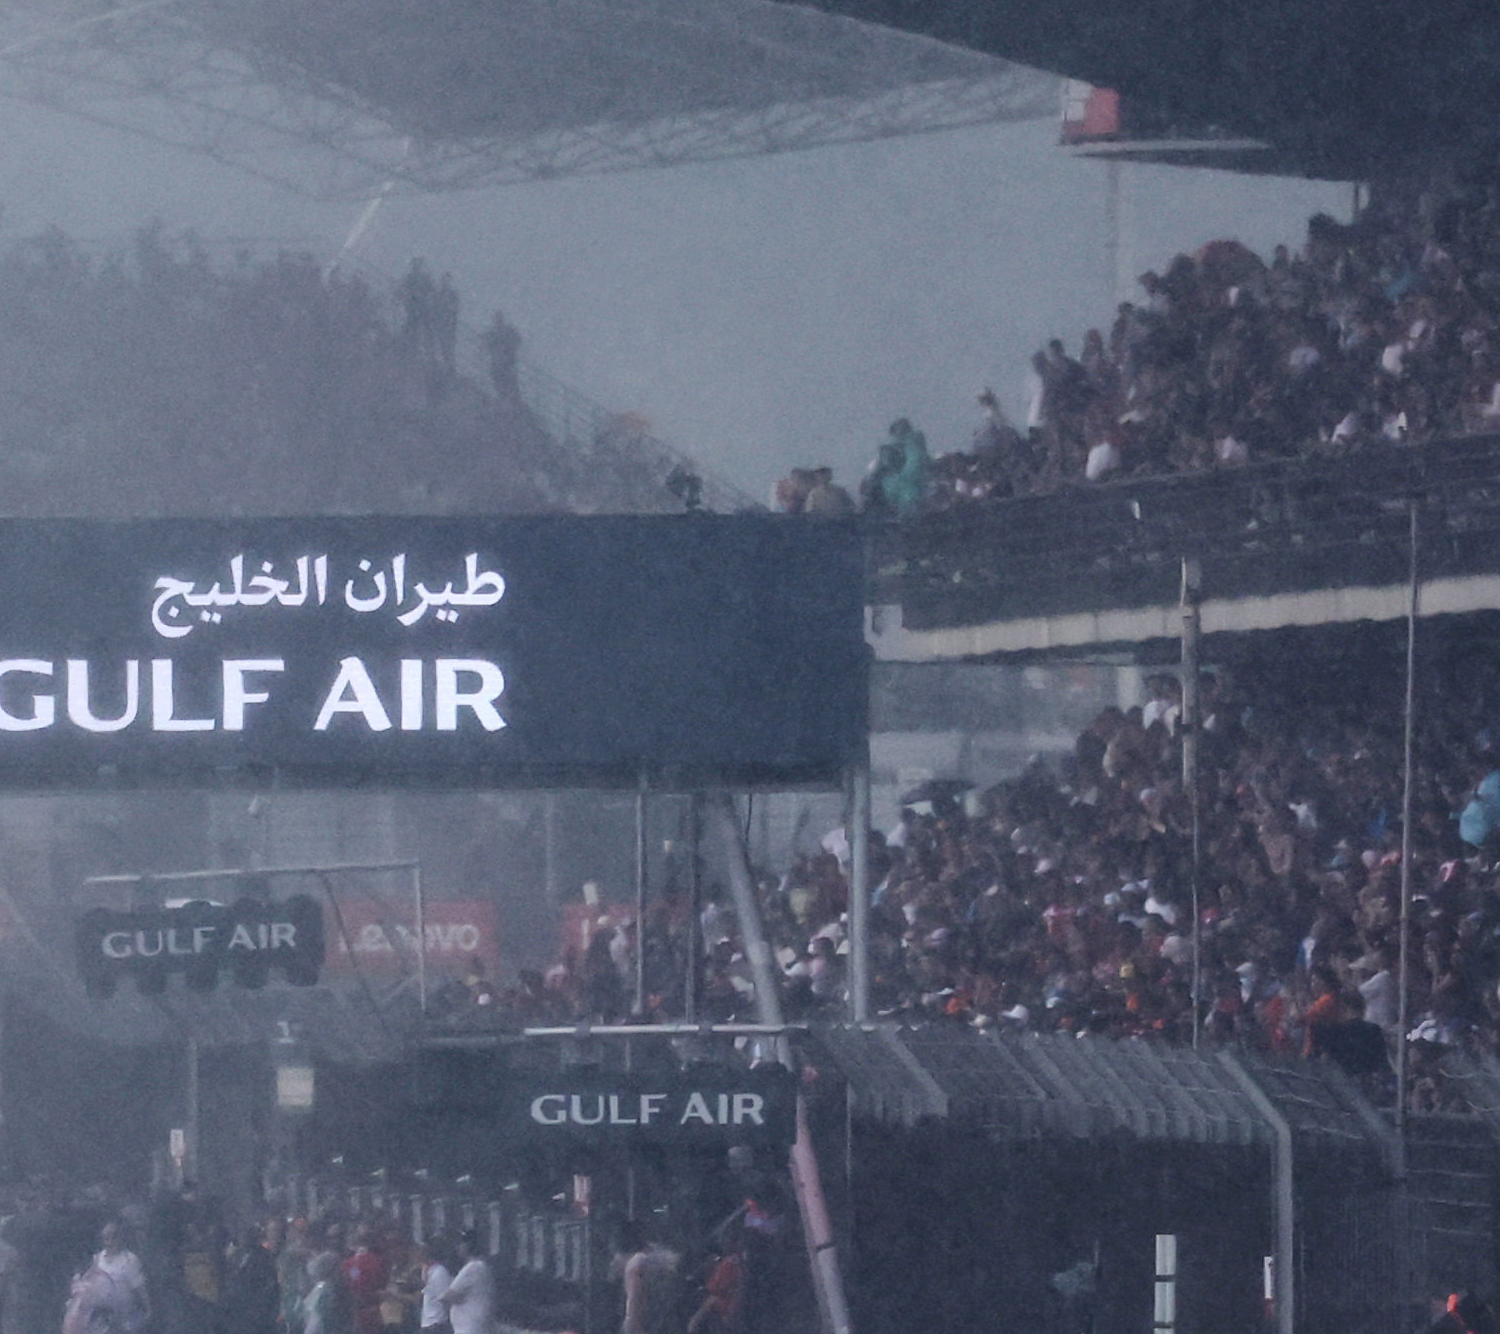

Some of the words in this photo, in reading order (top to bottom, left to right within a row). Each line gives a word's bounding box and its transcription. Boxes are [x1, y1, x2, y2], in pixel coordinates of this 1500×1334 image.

[151, 554, 327, 638] الخليج
[345, 553, 506, 626] طيران
[313, 657, 508, 732] AIR
[101, 926, 216, 960] GULF
[228, 922, 297, 951] AIR
[530, 1093, 668, 1126] GULF
[680, 1092, 765, 1126] AIR
